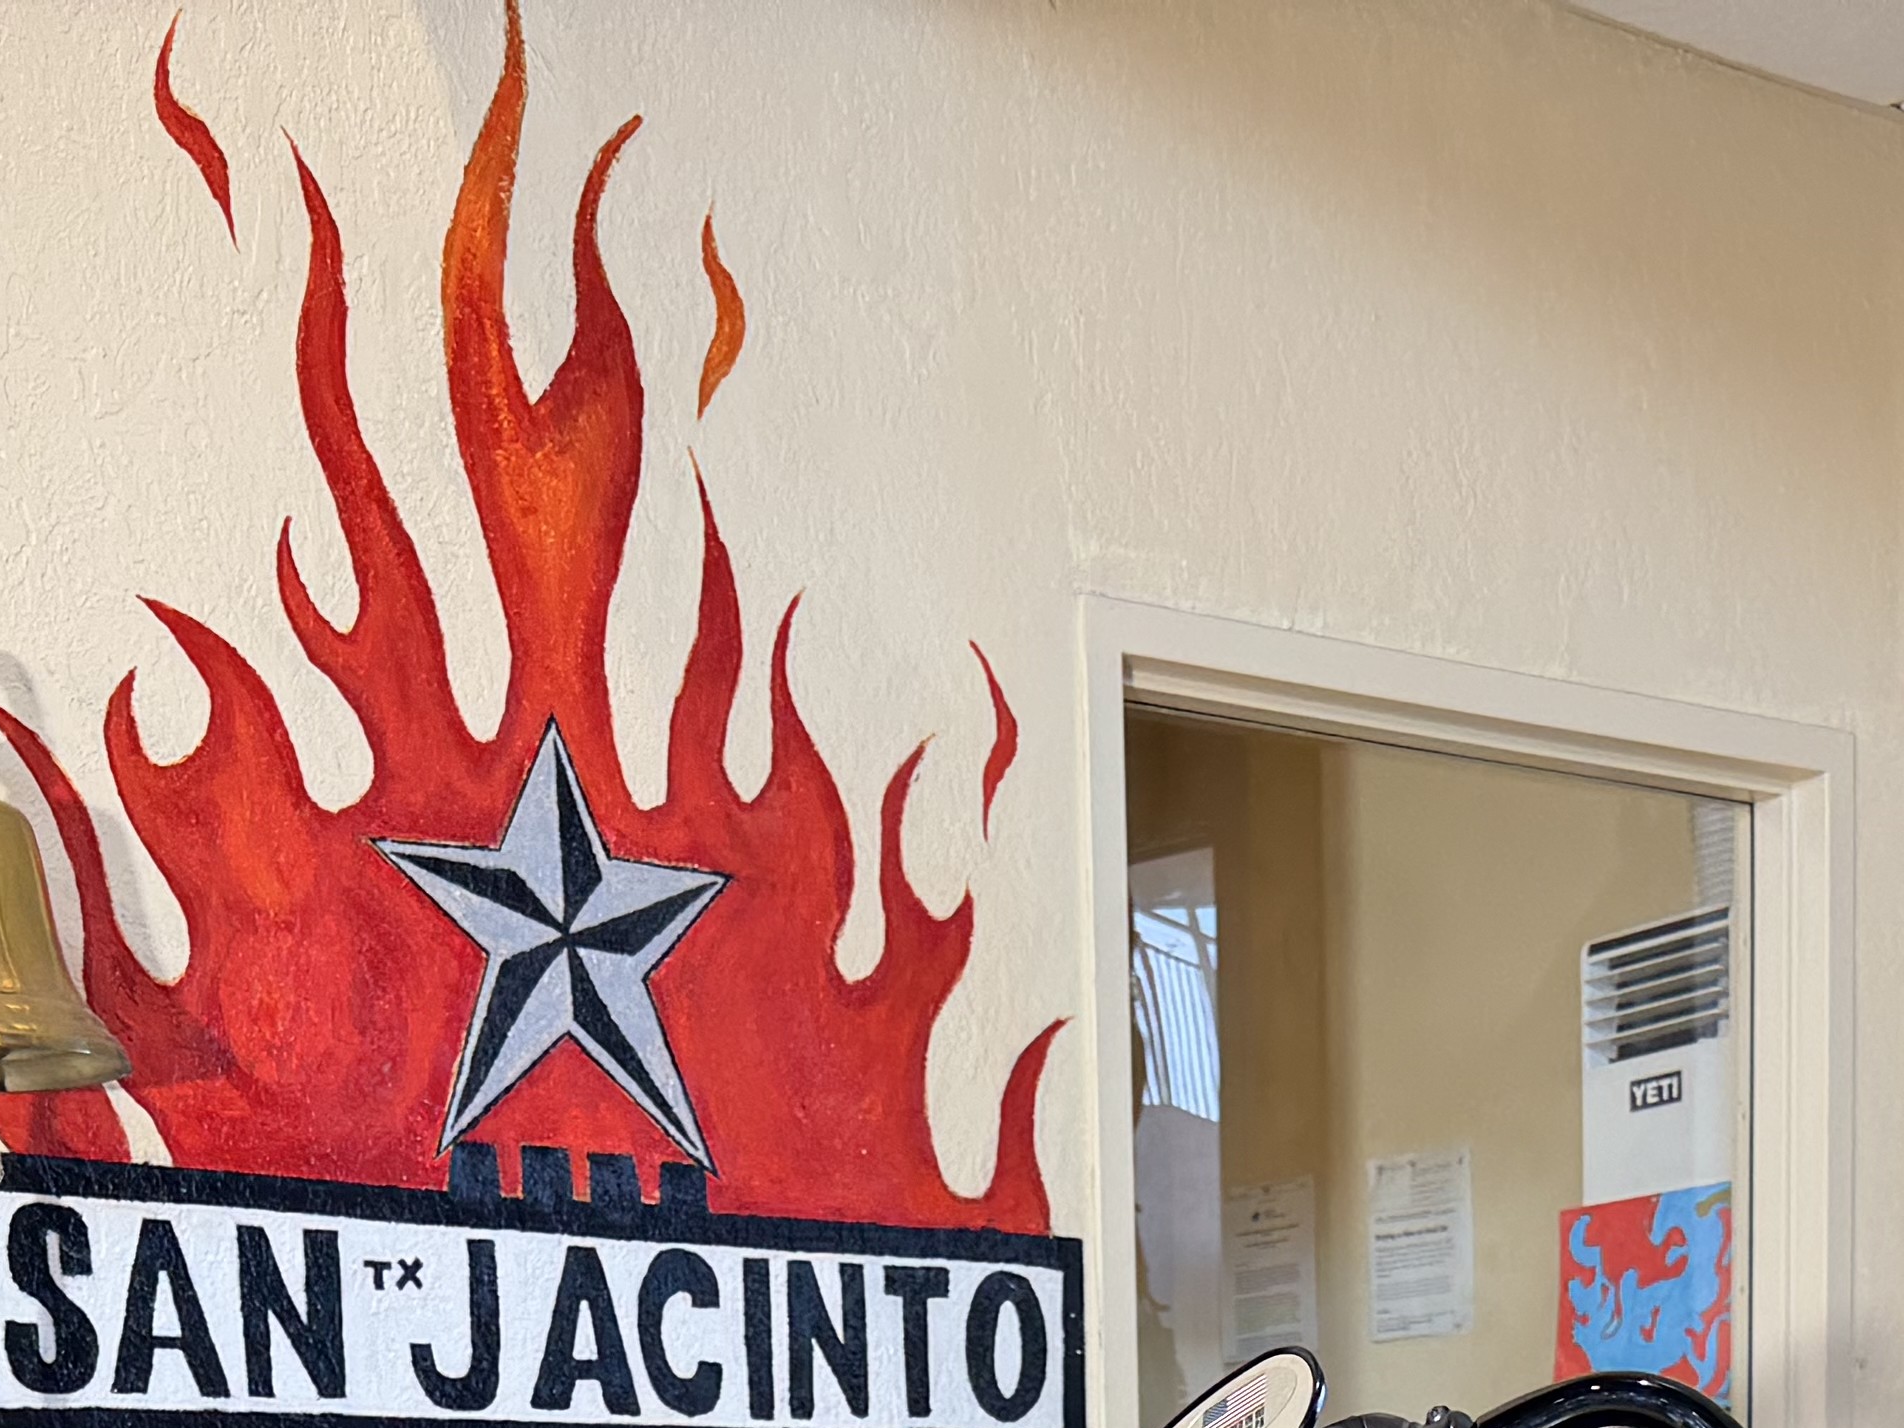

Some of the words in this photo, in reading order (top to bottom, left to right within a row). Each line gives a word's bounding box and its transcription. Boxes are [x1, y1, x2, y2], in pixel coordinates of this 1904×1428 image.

[1632, 1075, 1679, 1107] YETI
[4, 1202, 347, 1399] SAN
[364, 1257, 424, 1291] TX
[409, 1238, 1047, 1423] JACINTO
